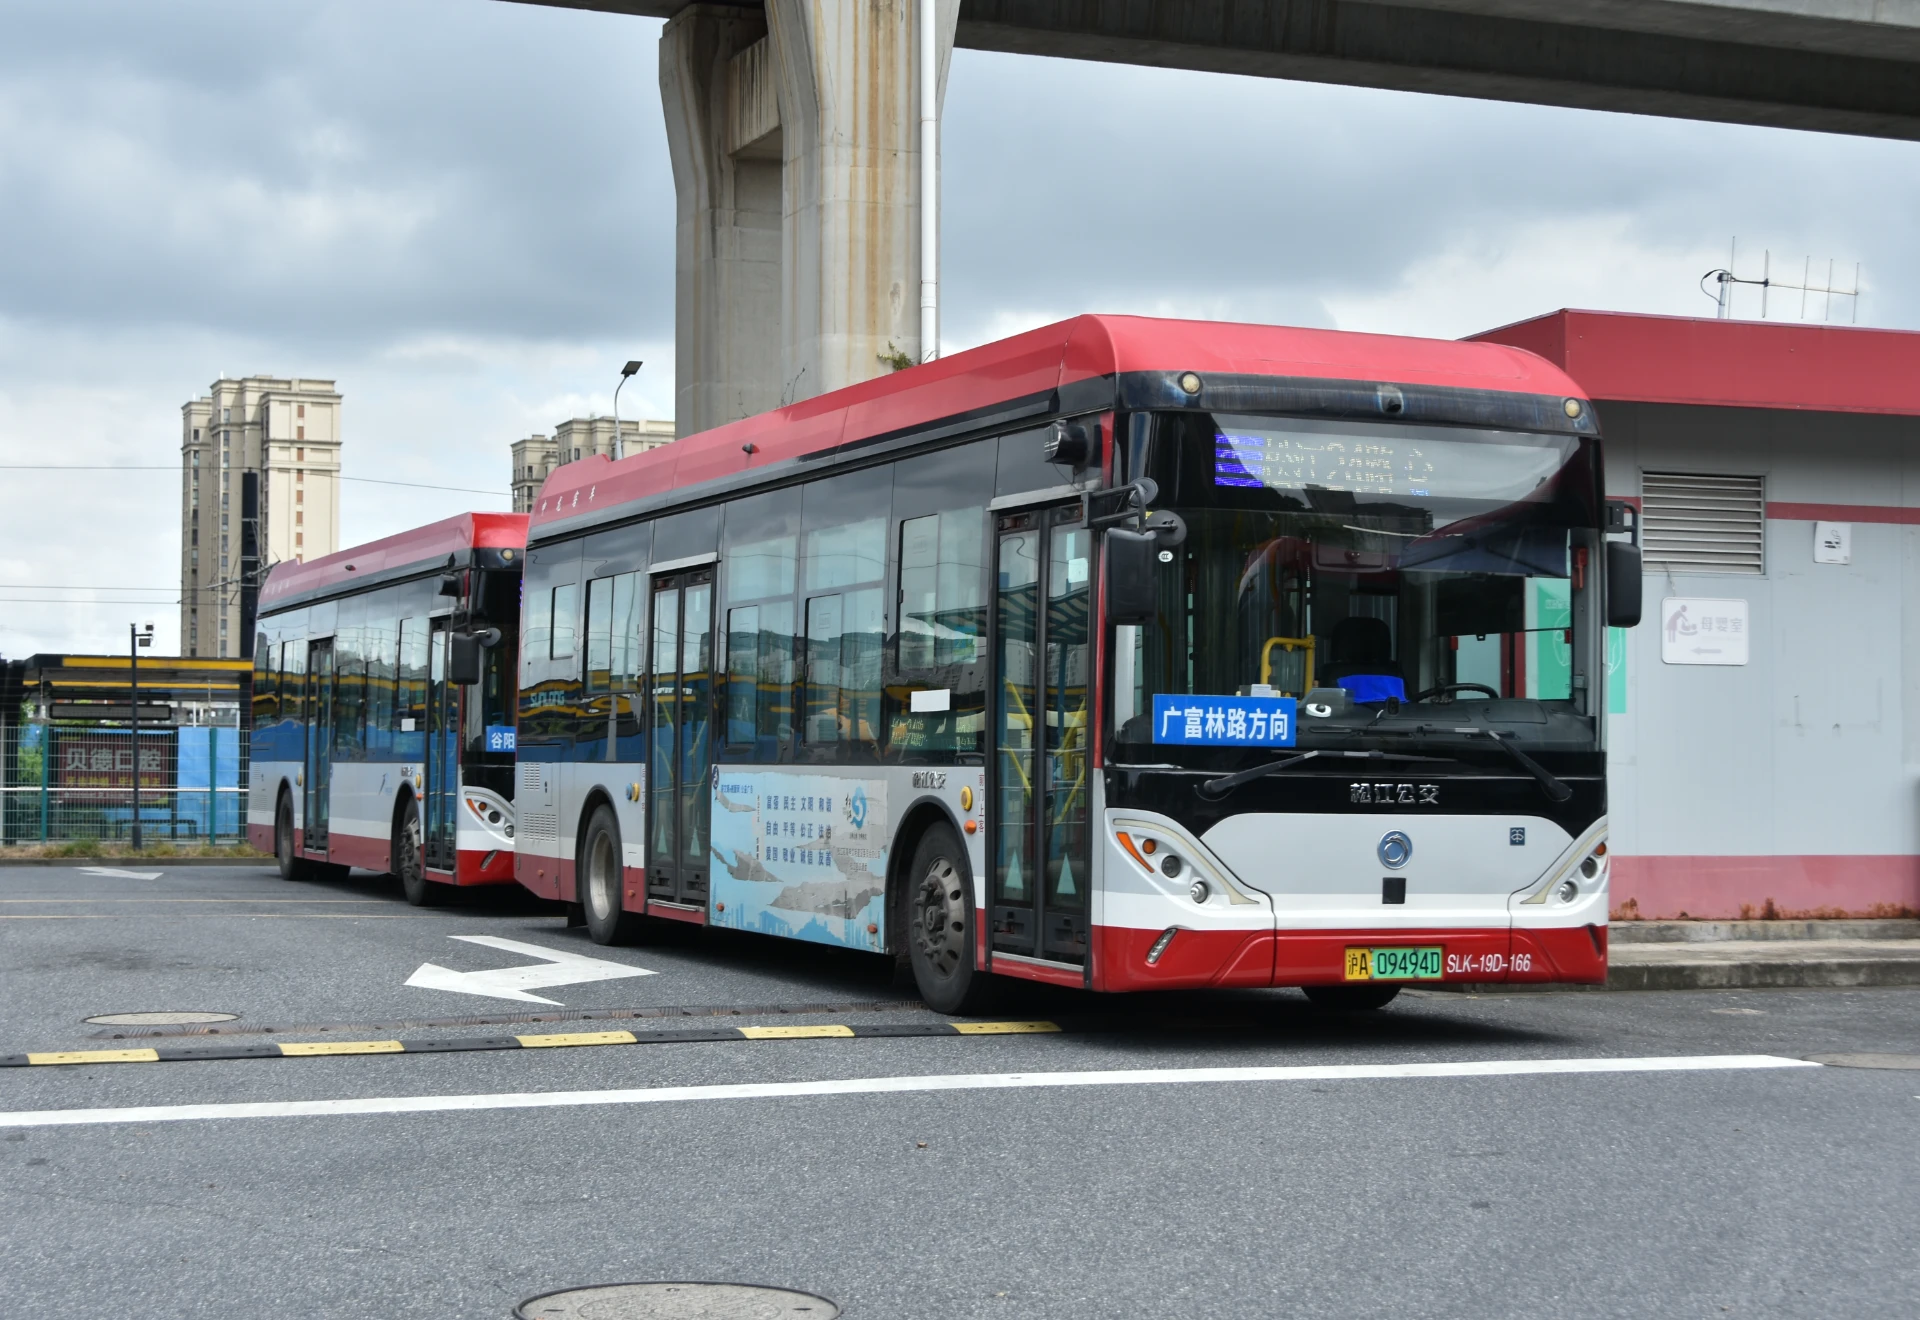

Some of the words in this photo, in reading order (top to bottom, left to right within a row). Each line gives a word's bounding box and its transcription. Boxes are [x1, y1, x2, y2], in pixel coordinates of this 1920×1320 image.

[1700, 616, 1743, 633] 母婴室
[1161, 706, 1288, 741] 广富林路方向
[491, 732, 515, 749] 谷阳
[65, 748, 162, 771] 贝德口腔
[912, 771, 947, 789] 松江公交
[1349, 783, 1440, 804] 松江公交
[783, 796, 796, 811] 民主
[801, 797, 814, 812] 文明
[766, 821, 779, 836] 自由
[783, 822, 796, 837] 平等
[800, 823, 813, 838] 公正
[1447, 953, 1531, 973] SLK-19D-166
